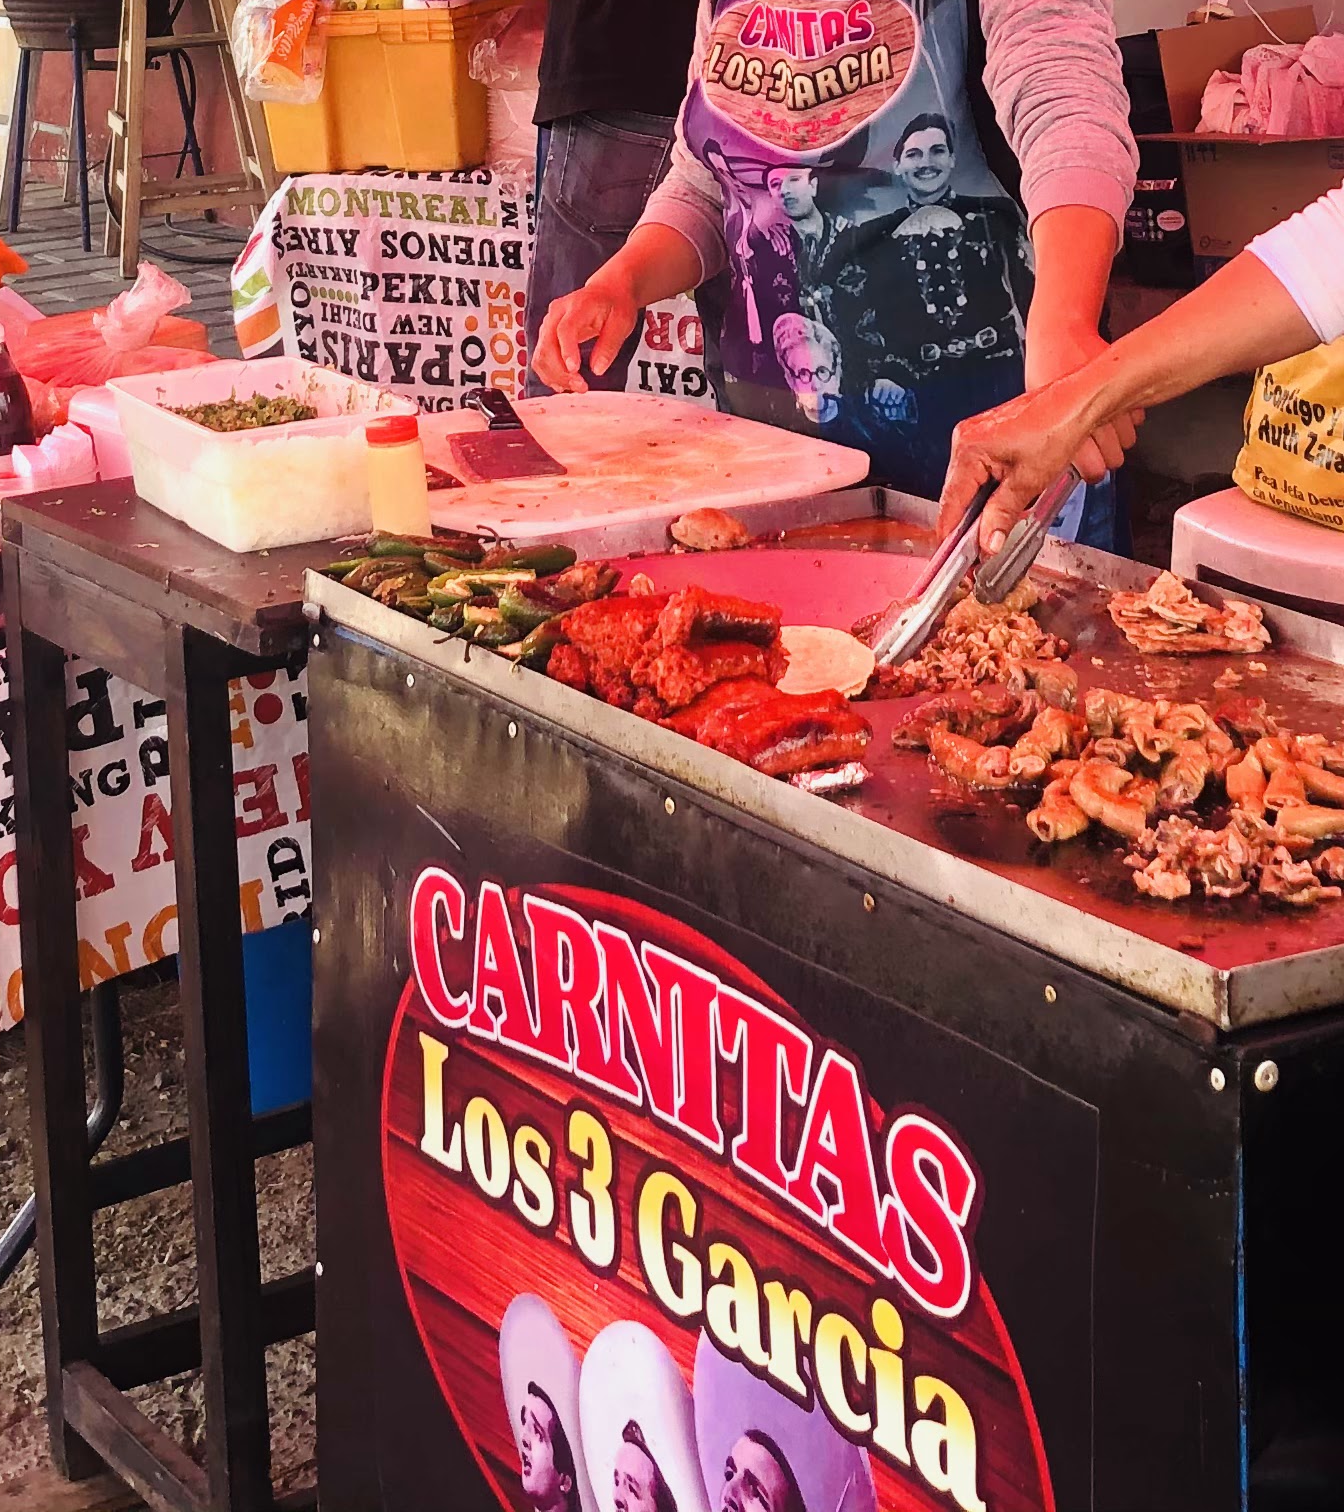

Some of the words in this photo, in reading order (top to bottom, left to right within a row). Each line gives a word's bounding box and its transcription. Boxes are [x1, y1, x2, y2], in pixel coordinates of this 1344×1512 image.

[706, 42, 765, 96] LOS
[786, 43, 895, 112] ARCIA
[286, 186, 498, 227] MONTREAL
[272, 226, 360, 261] AIRES
[381, 229, 525, 270] BUENOS
[360, 269, 482, 308] PEKIN
[320, 301, 378, 334] DELHI
[389, 313, 453, 338] NEW
[320, 328, 455, 387] PARIS
[1263, 371, 1326, 427] Contigo
[409, 865, 977, 1319] CARNITAS
[418, 1030, 556, 1229] Los
[567, 1108, 617, 1270] 3
[637, 1169, 989, 1511] Garcia
